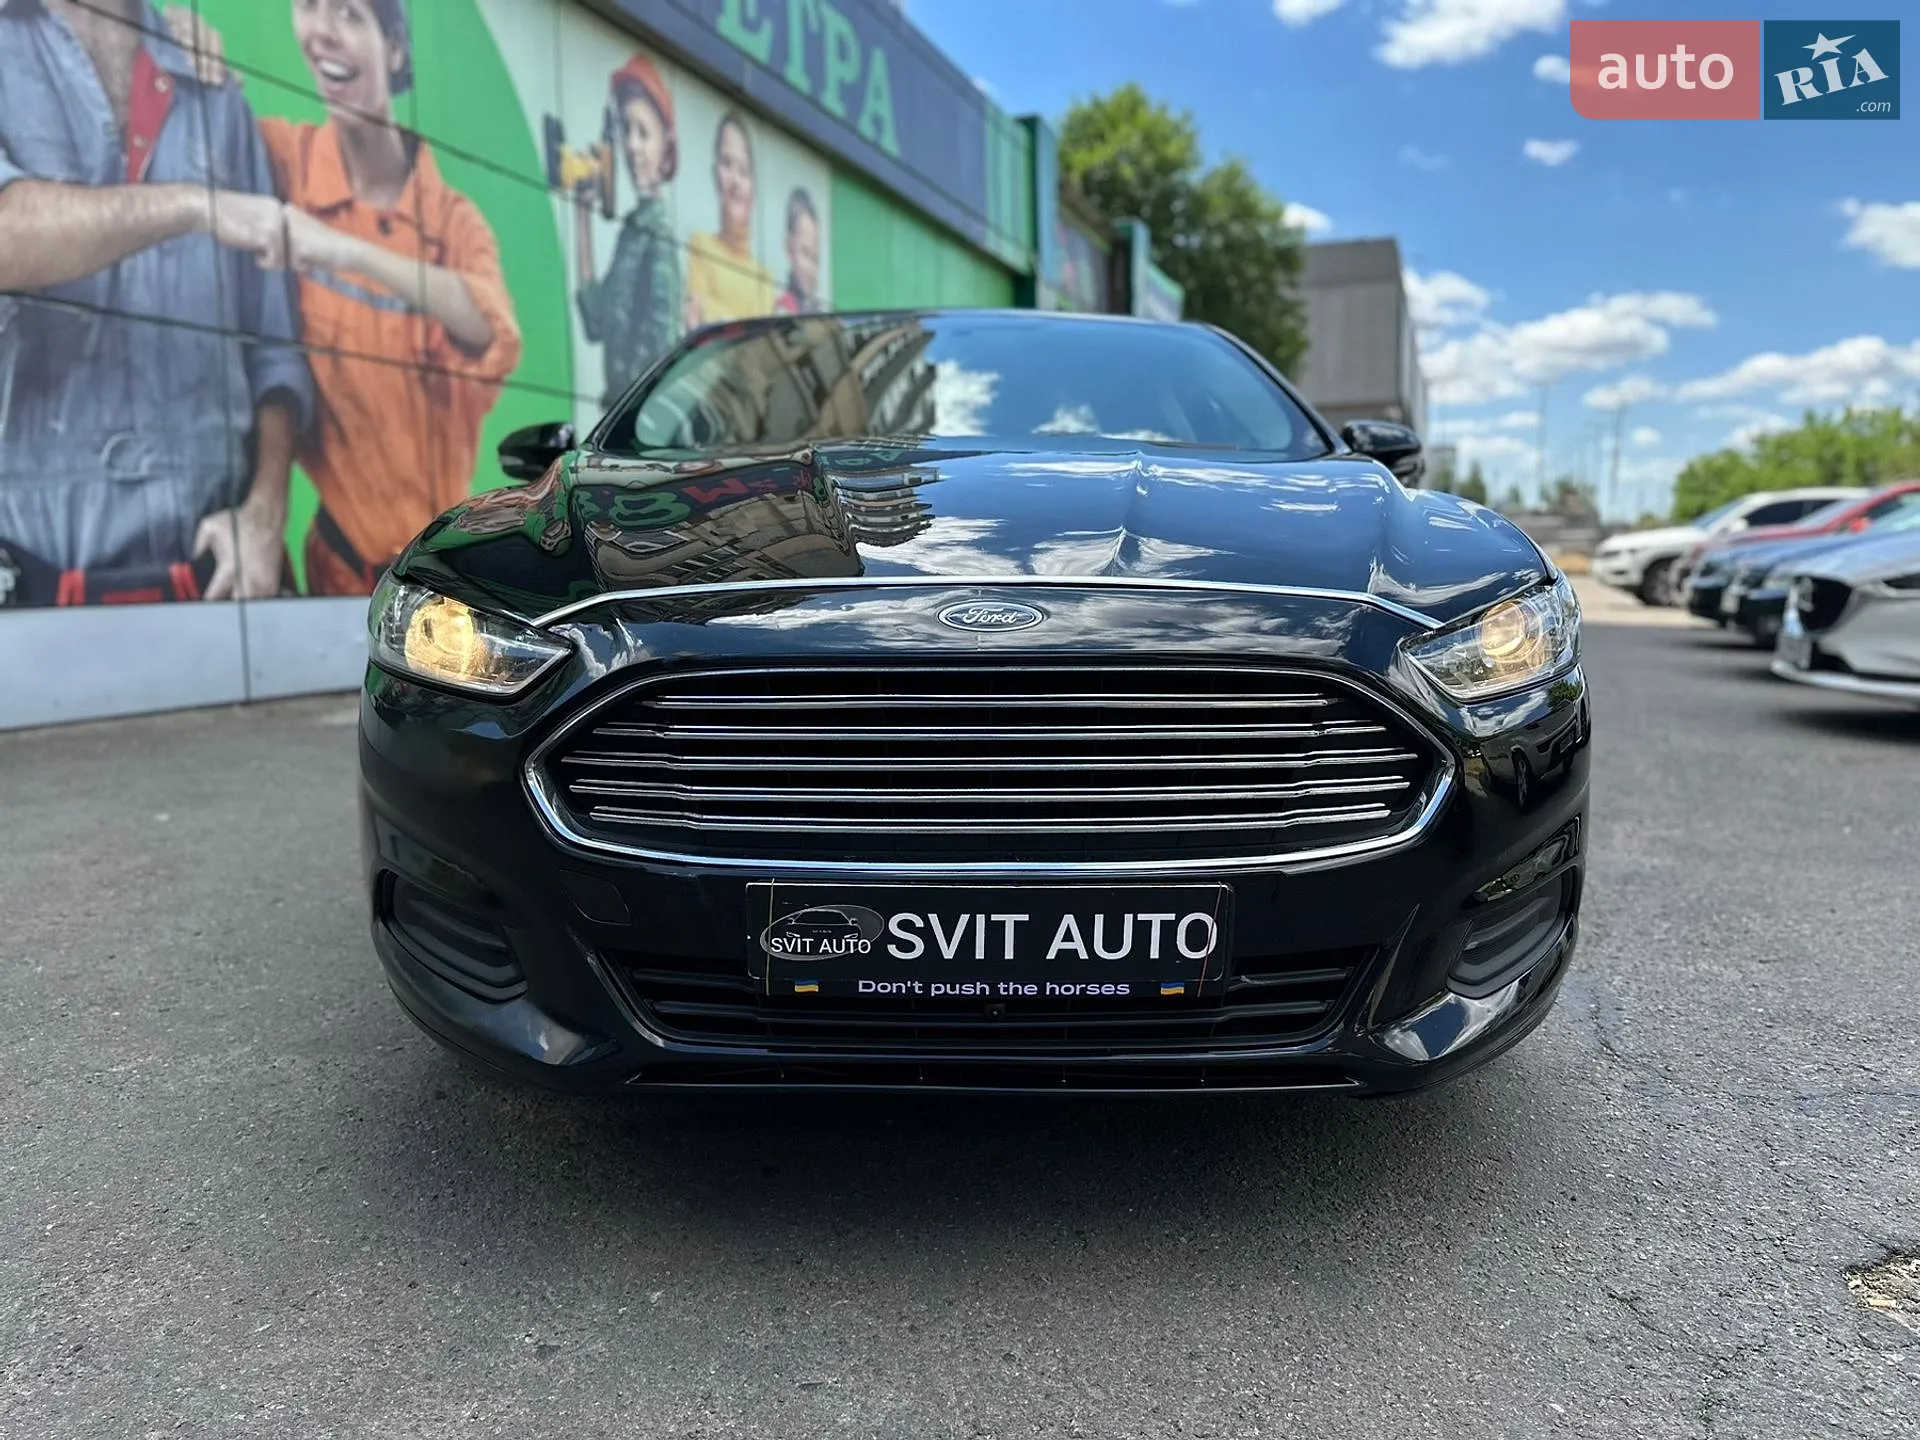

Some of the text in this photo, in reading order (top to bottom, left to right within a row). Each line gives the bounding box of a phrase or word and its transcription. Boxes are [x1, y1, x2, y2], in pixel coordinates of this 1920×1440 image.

[962, 607, 1018, 624] Ford
[887, 912, 1218, 960] SVIT AUTO
[770, 937, 872, 954] SVIT AUTO
[857, 979, 1130, 997] Don't push the horses
